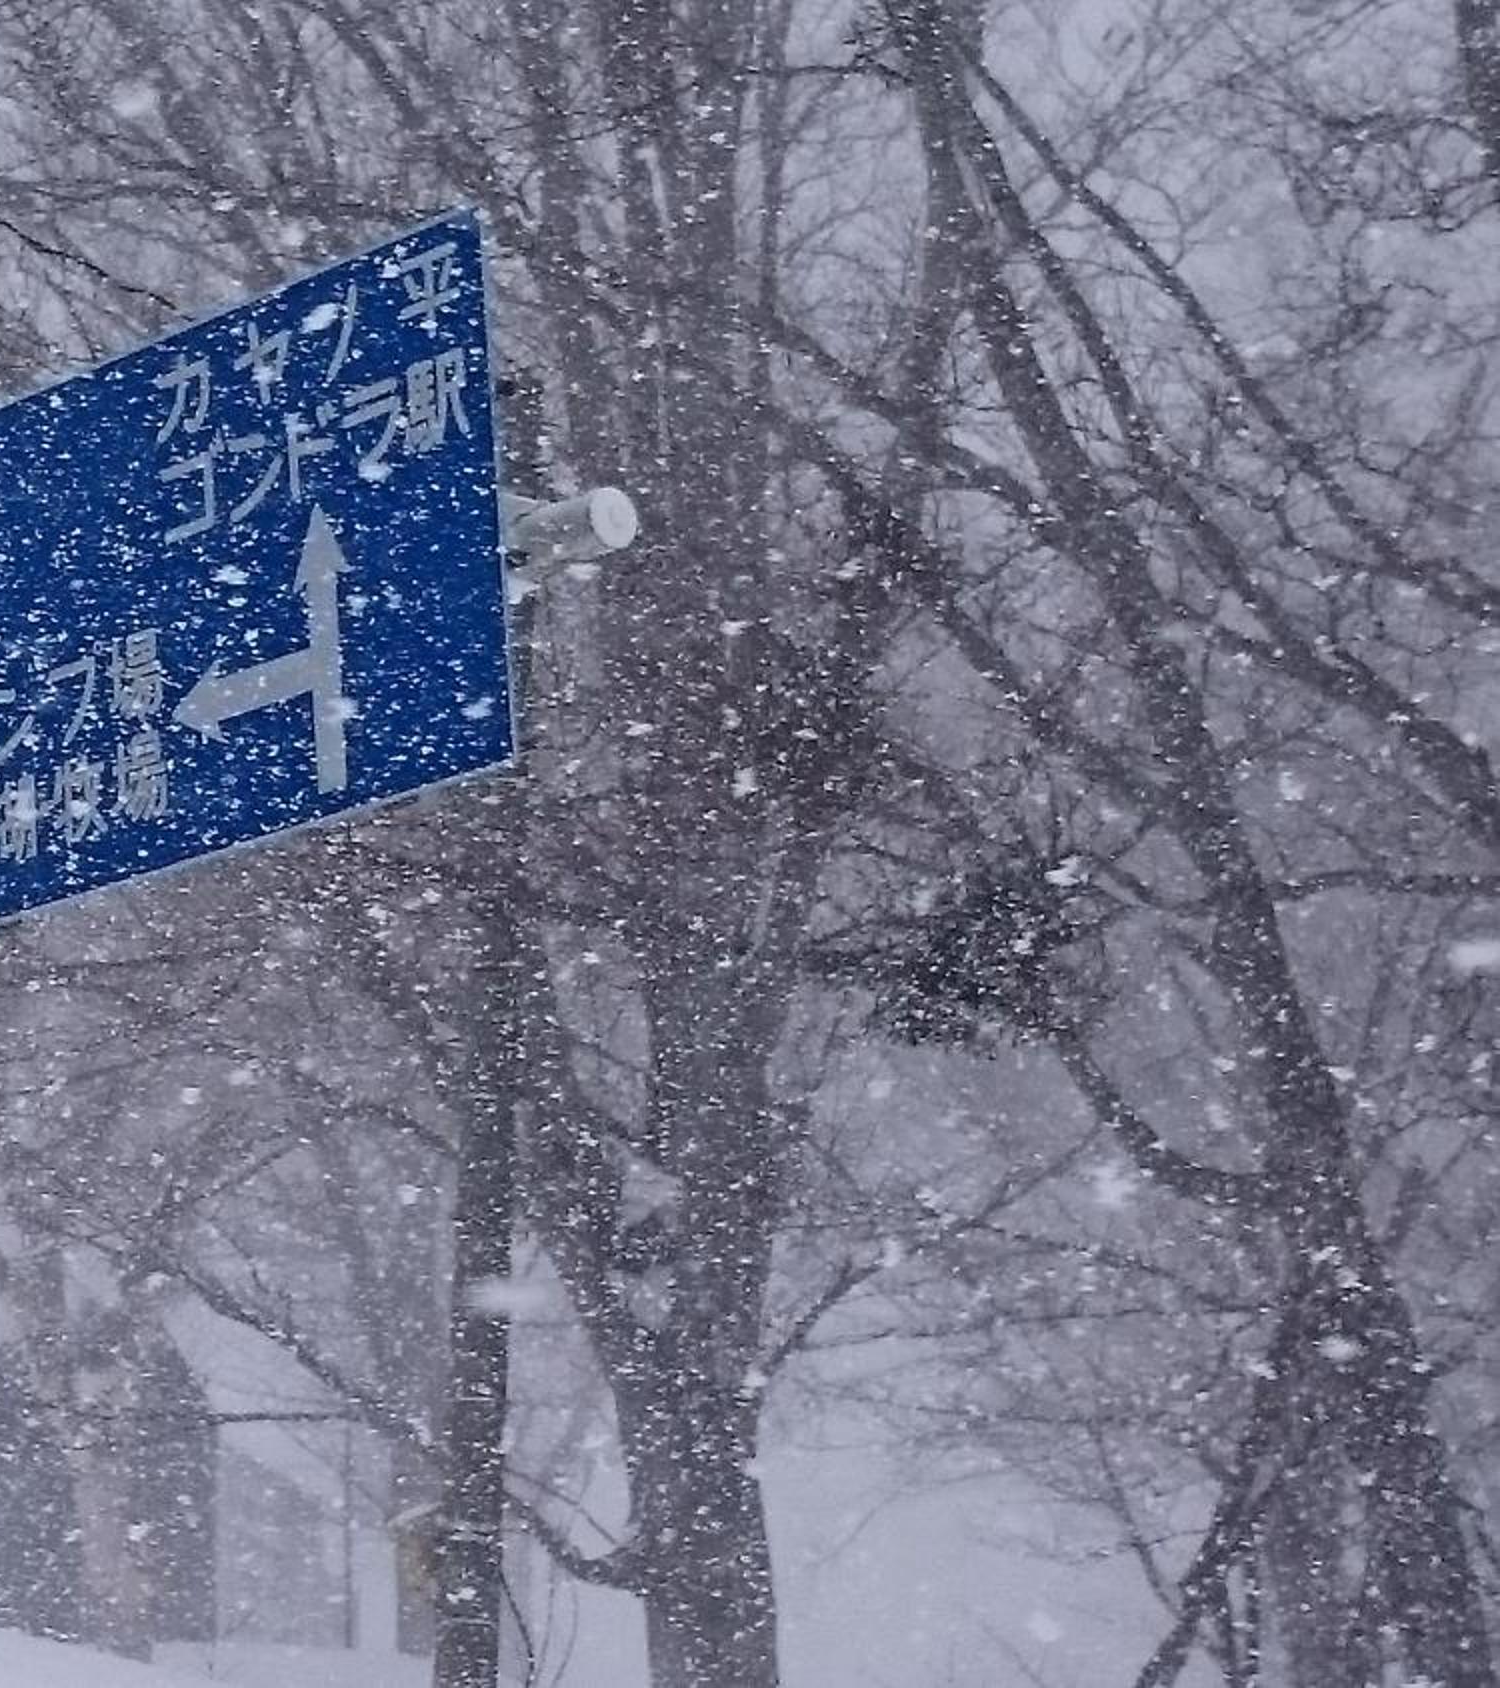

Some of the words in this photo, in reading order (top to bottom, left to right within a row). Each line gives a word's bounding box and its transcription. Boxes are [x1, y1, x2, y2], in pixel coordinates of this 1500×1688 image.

[154, 241, 461, 445] カヤノ平
[157, 347, 473, 546] ゴンドラ駅
